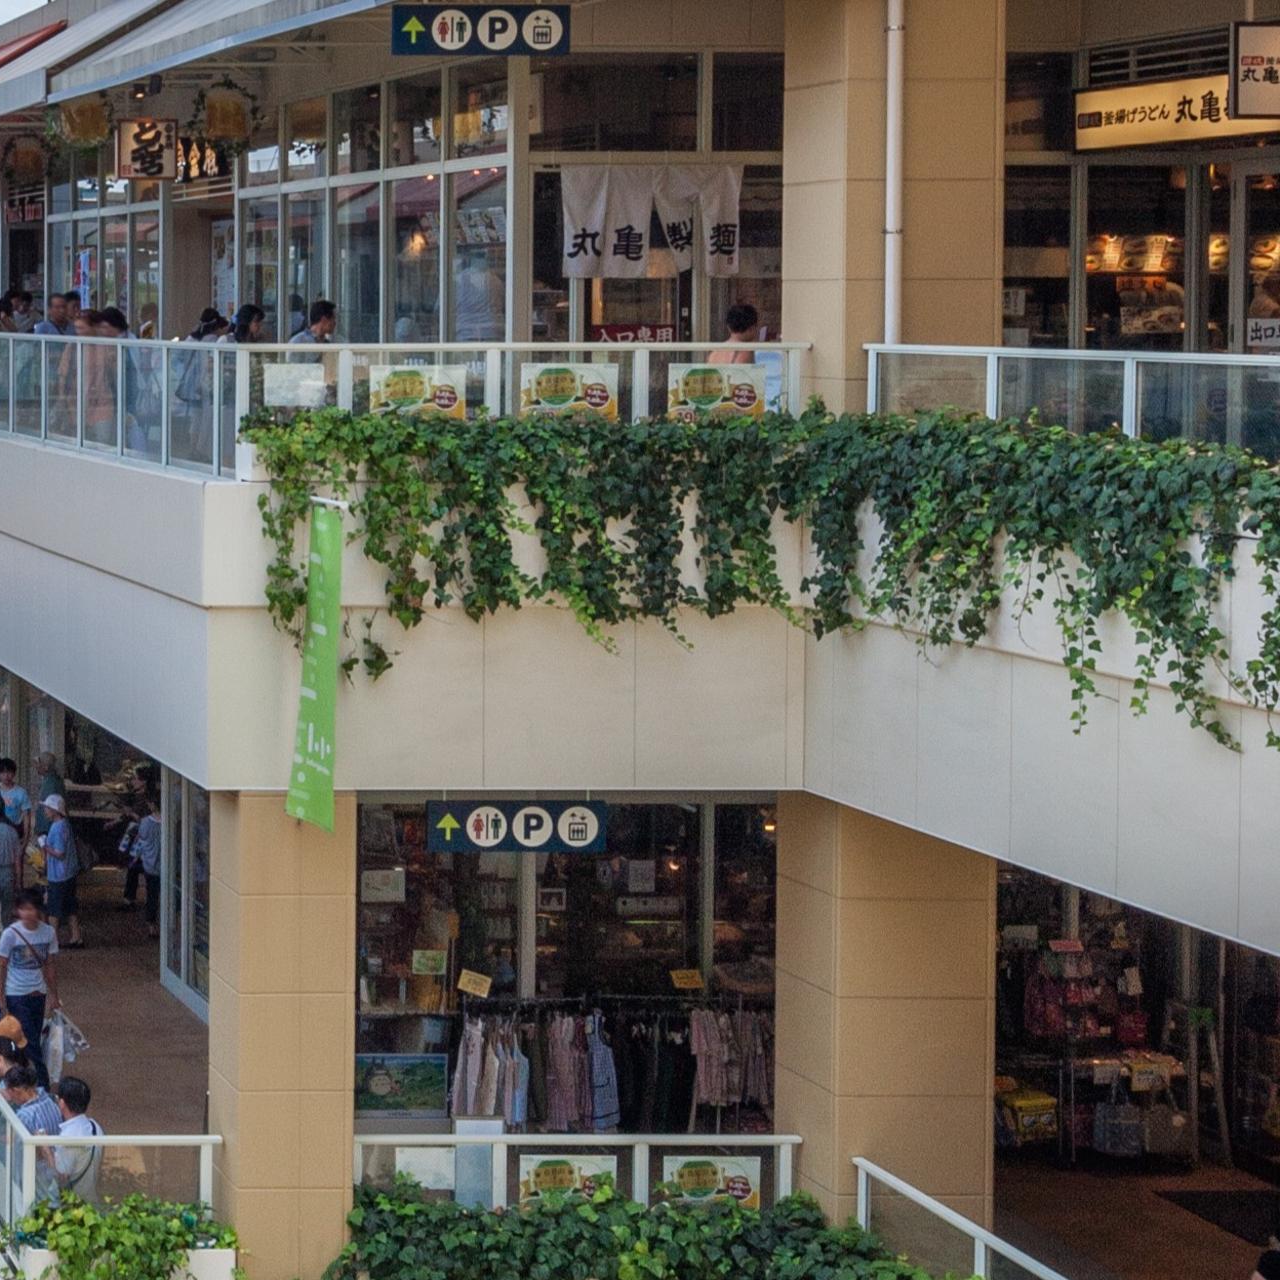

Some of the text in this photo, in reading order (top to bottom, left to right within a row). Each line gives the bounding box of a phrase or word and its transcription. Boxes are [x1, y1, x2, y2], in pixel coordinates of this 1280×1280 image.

[1174, 90, 1228, 124] 丸亀
[1250, 321, 1280, 343] 出口
[523, 813, 543, 840] P
